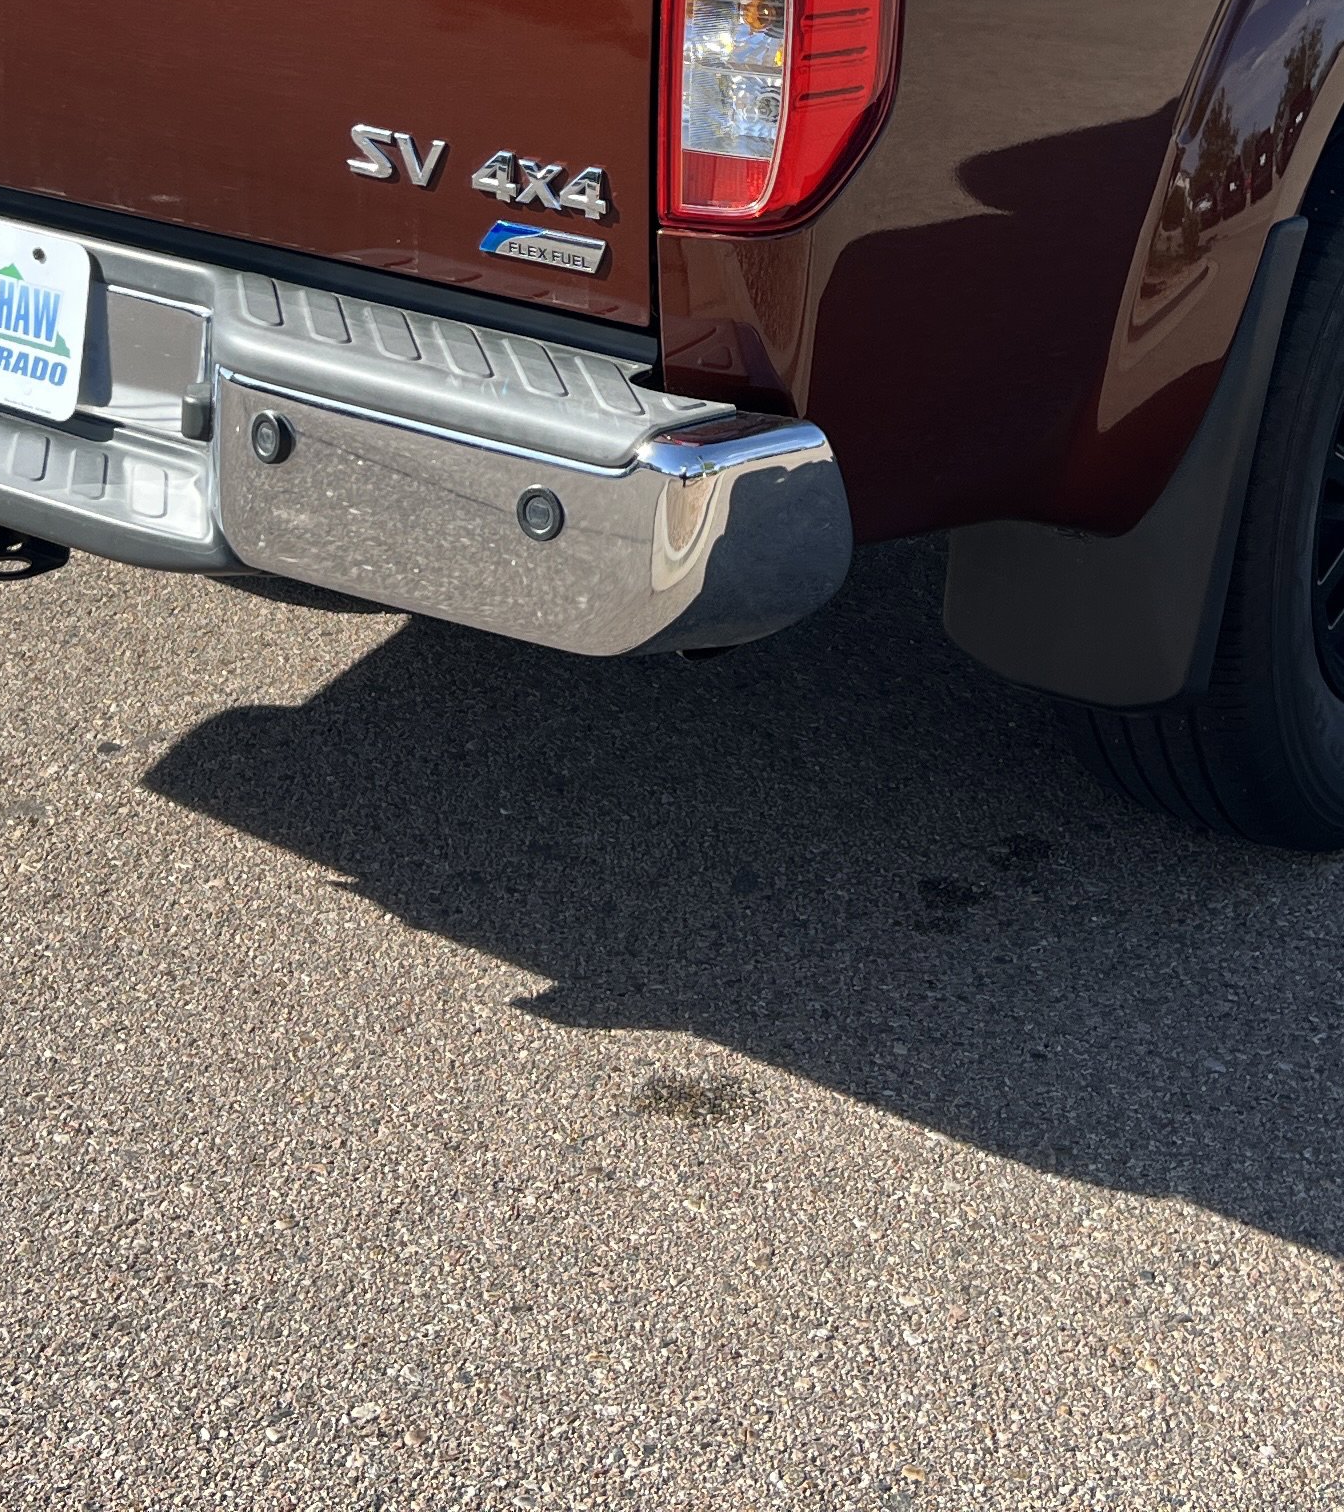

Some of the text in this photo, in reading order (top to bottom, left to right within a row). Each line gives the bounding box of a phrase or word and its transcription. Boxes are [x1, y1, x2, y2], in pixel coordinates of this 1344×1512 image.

[346, 123, 446, 188] SV
[507, 240, 592, 270] FLEX FUEL
